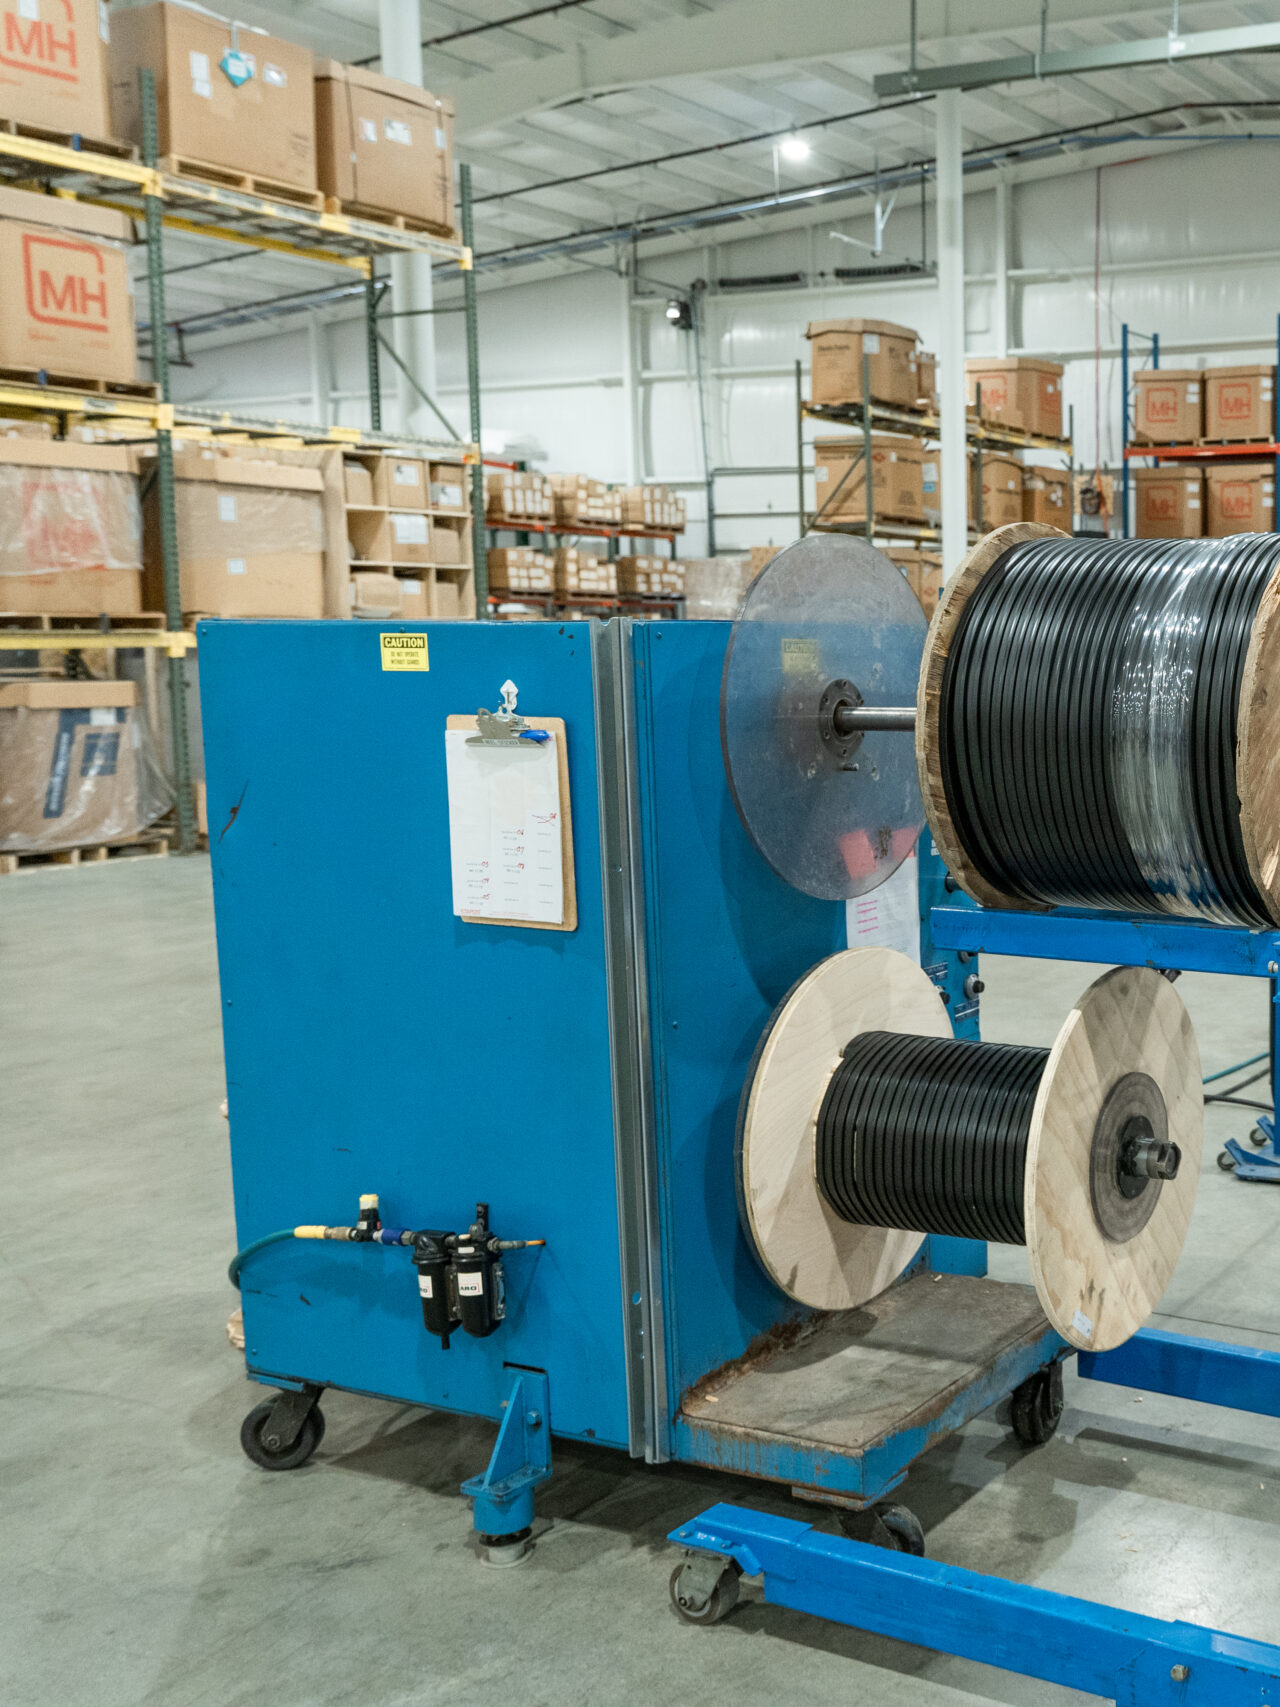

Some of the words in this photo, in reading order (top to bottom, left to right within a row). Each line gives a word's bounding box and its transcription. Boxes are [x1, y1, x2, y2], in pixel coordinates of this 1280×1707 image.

[5, 11, 78, 69] MH
[39, 269, 107, 319] MH
[1150, 400, 1177, 417] MH
[1224, 396, 1252, 414] MH
[1225, 496, 1253, 513] MH
[385, 638, 424, 648] CAUTION
